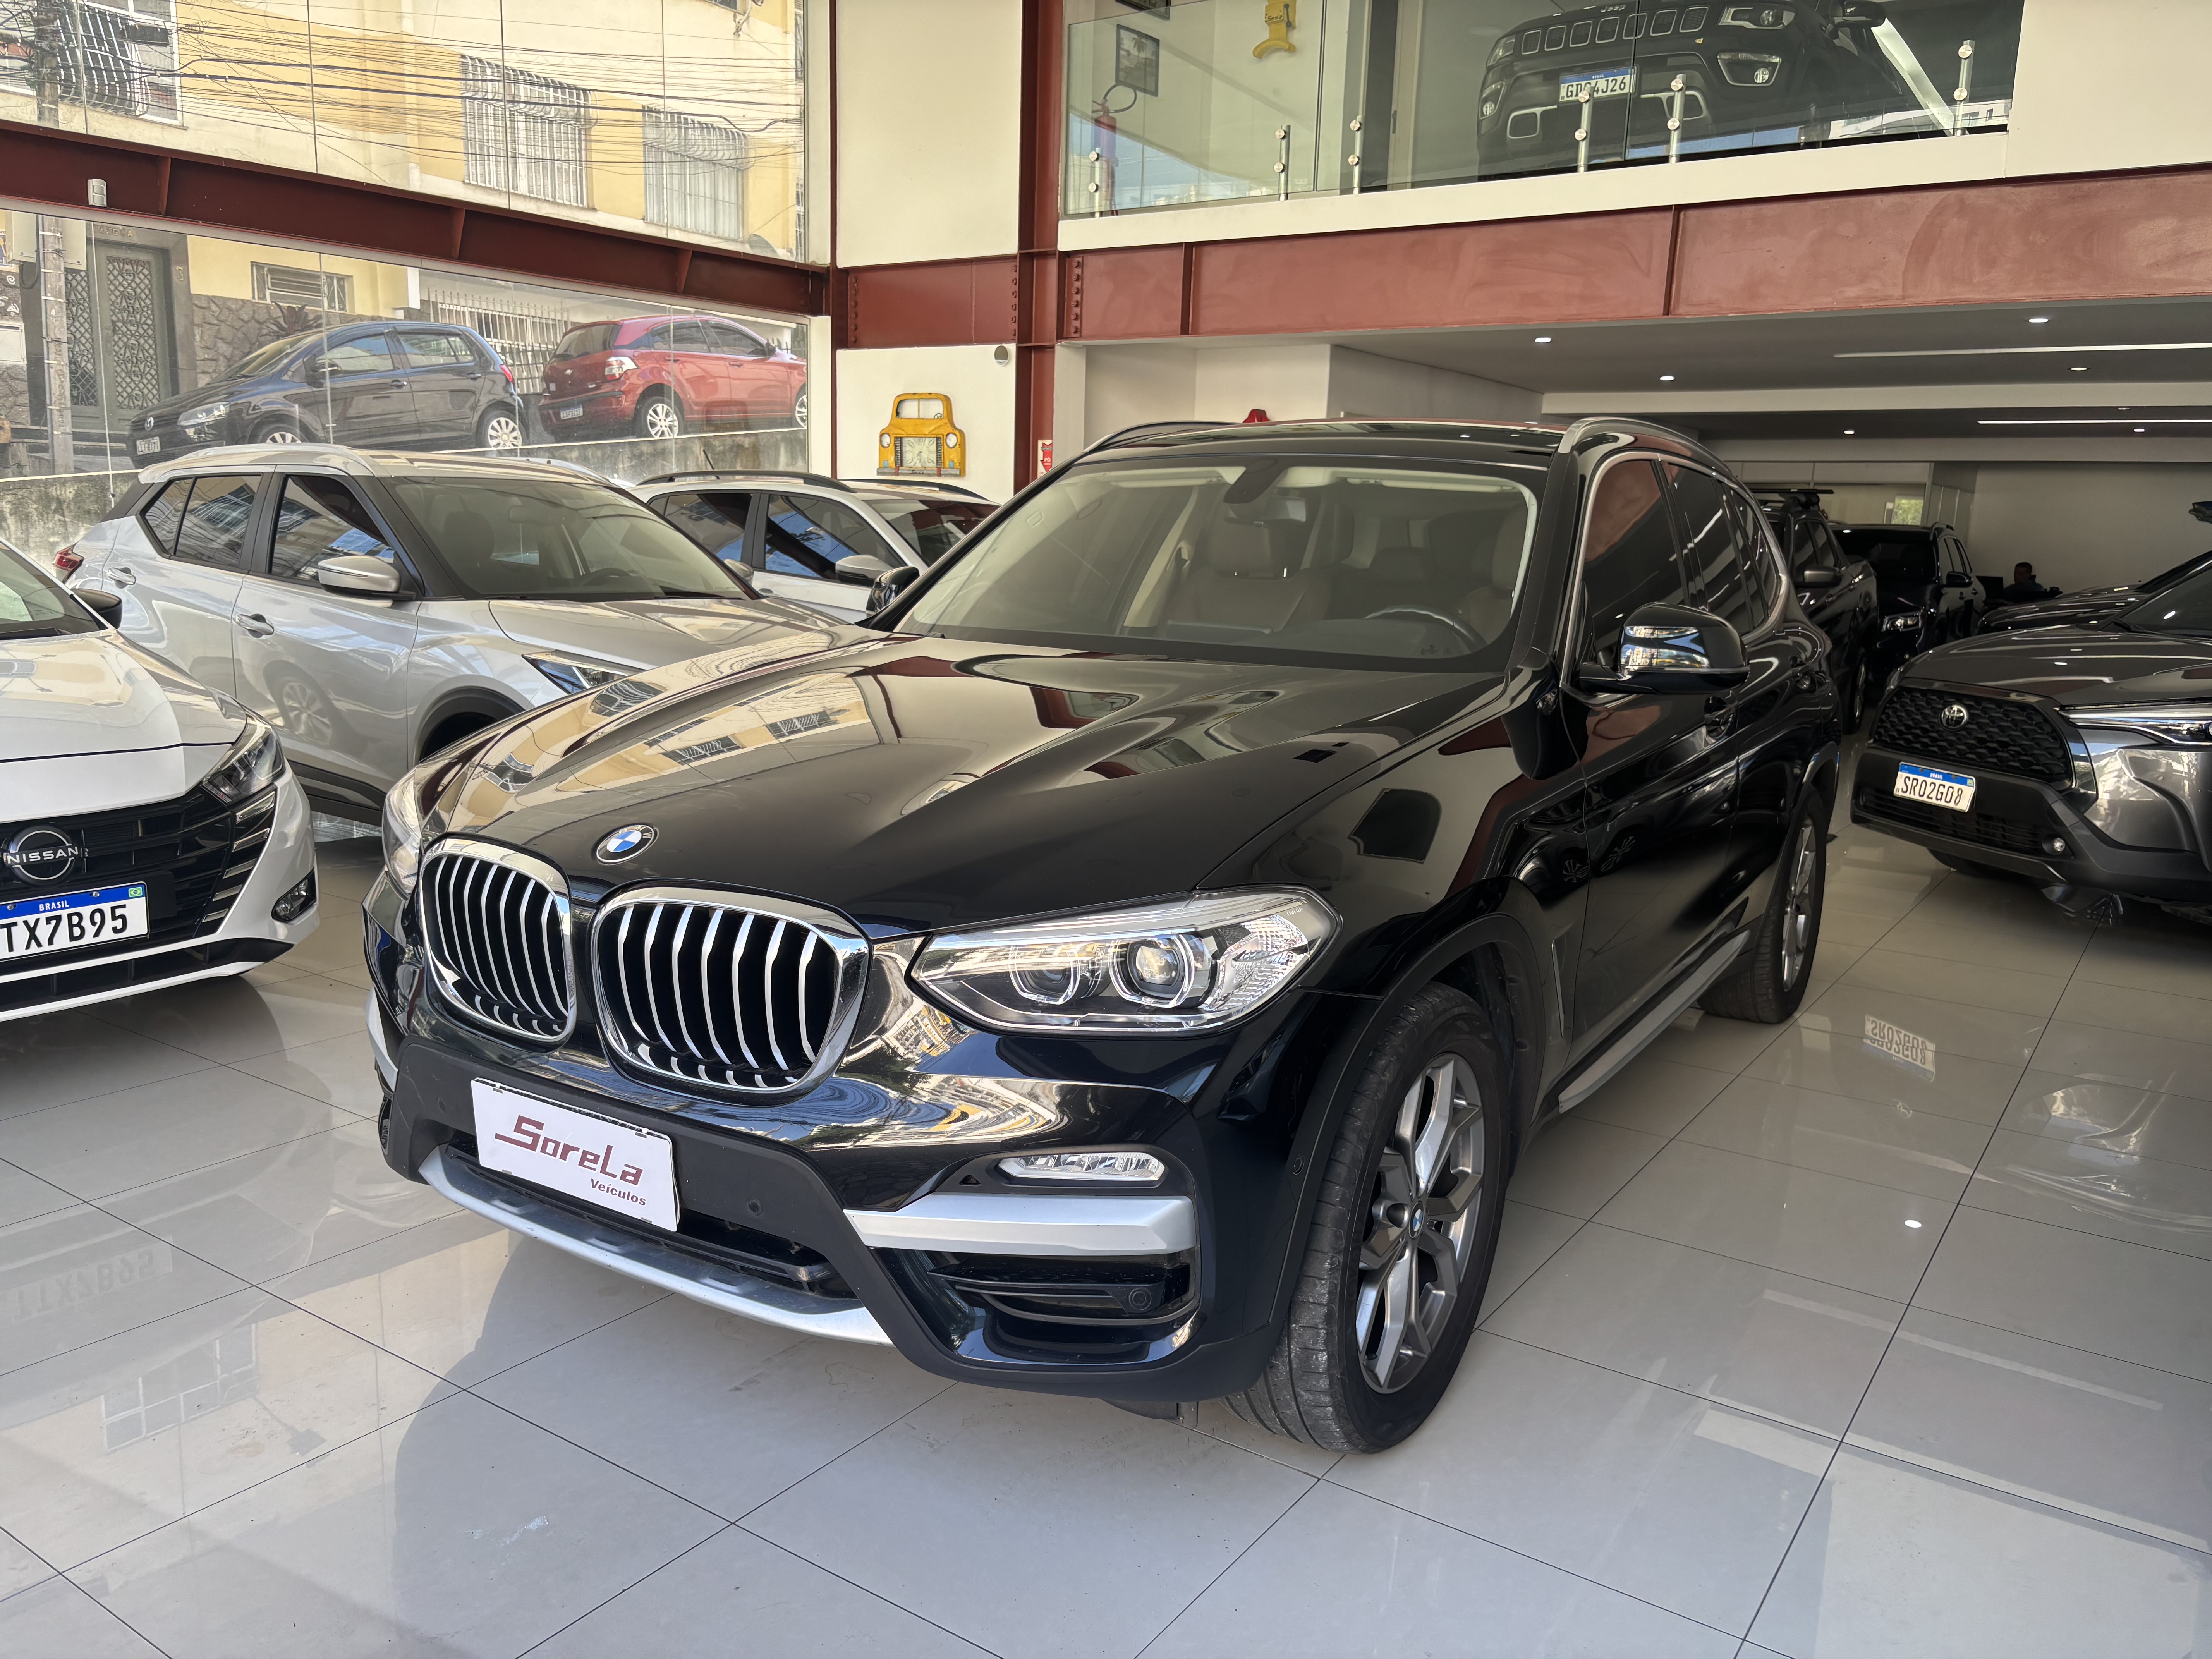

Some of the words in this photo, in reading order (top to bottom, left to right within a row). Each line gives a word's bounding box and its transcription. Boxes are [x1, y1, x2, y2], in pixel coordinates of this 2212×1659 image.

[7, 846, 79, 864] NISSAN
[39, 900, 69, 911] BRASIL
[0, 904, 128, 953] TX7B95
[591, 1178, 646, 1206] Veículos
